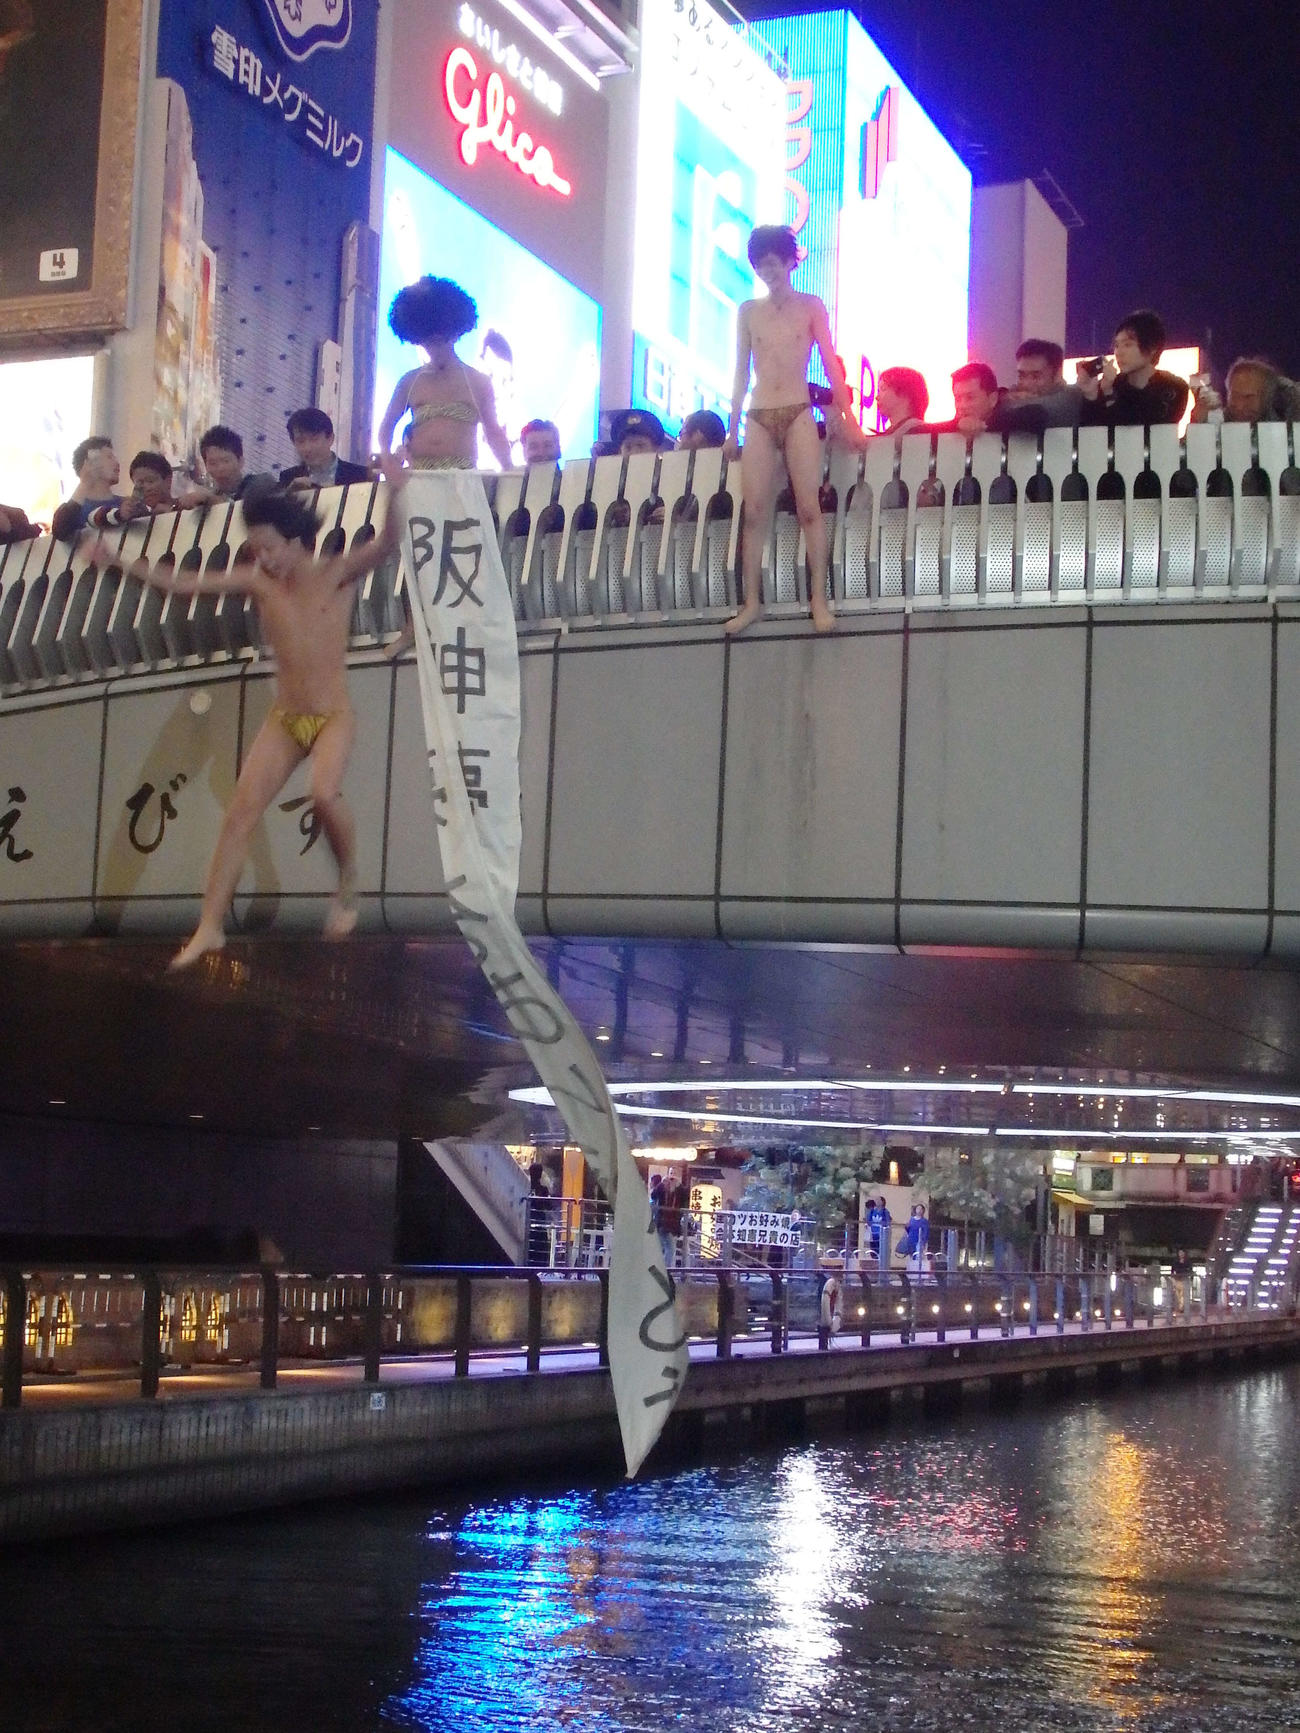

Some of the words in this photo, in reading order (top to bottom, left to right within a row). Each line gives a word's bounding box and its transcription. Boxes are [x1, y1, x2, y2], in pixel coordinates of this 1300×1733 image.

[211, 24, 363, 168] 雪印メグミルク
[445, 47, 571, 197] Glico
[52, 252, 66, 269] 4
